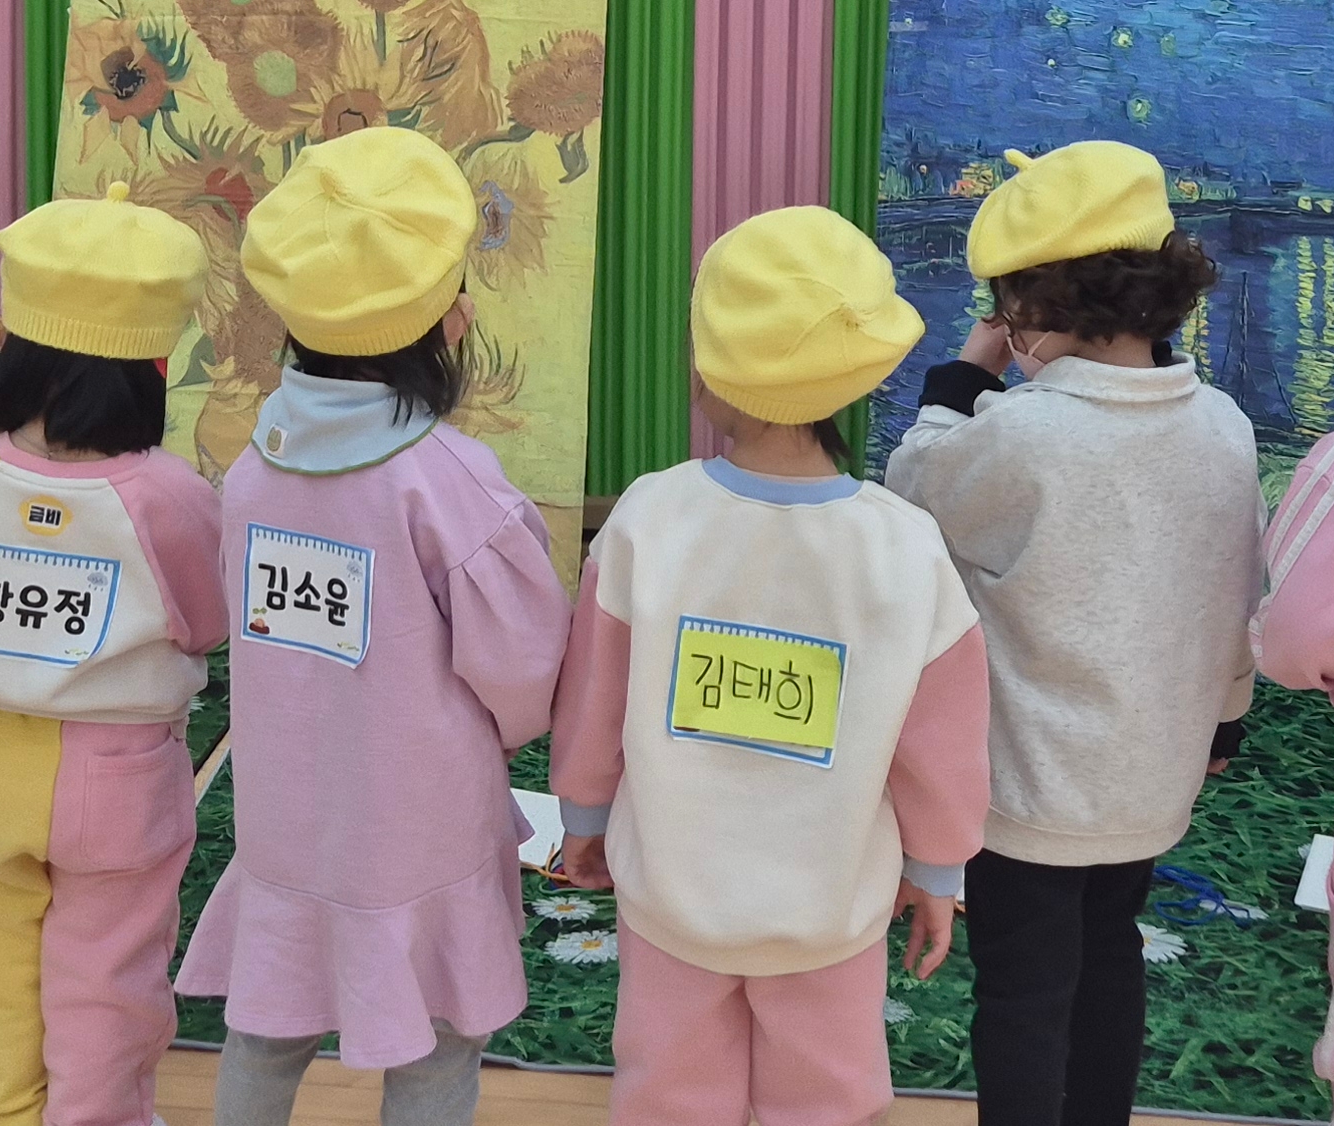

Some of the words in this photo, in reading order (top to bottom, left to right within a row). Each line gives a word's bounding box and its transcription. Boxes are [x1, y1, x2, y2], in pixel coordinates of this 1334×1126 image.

[29, 505, 62, 526] 금비
[258, 563, 351, 628] 김소윤
[690, 653, 814, 725] 김태희
